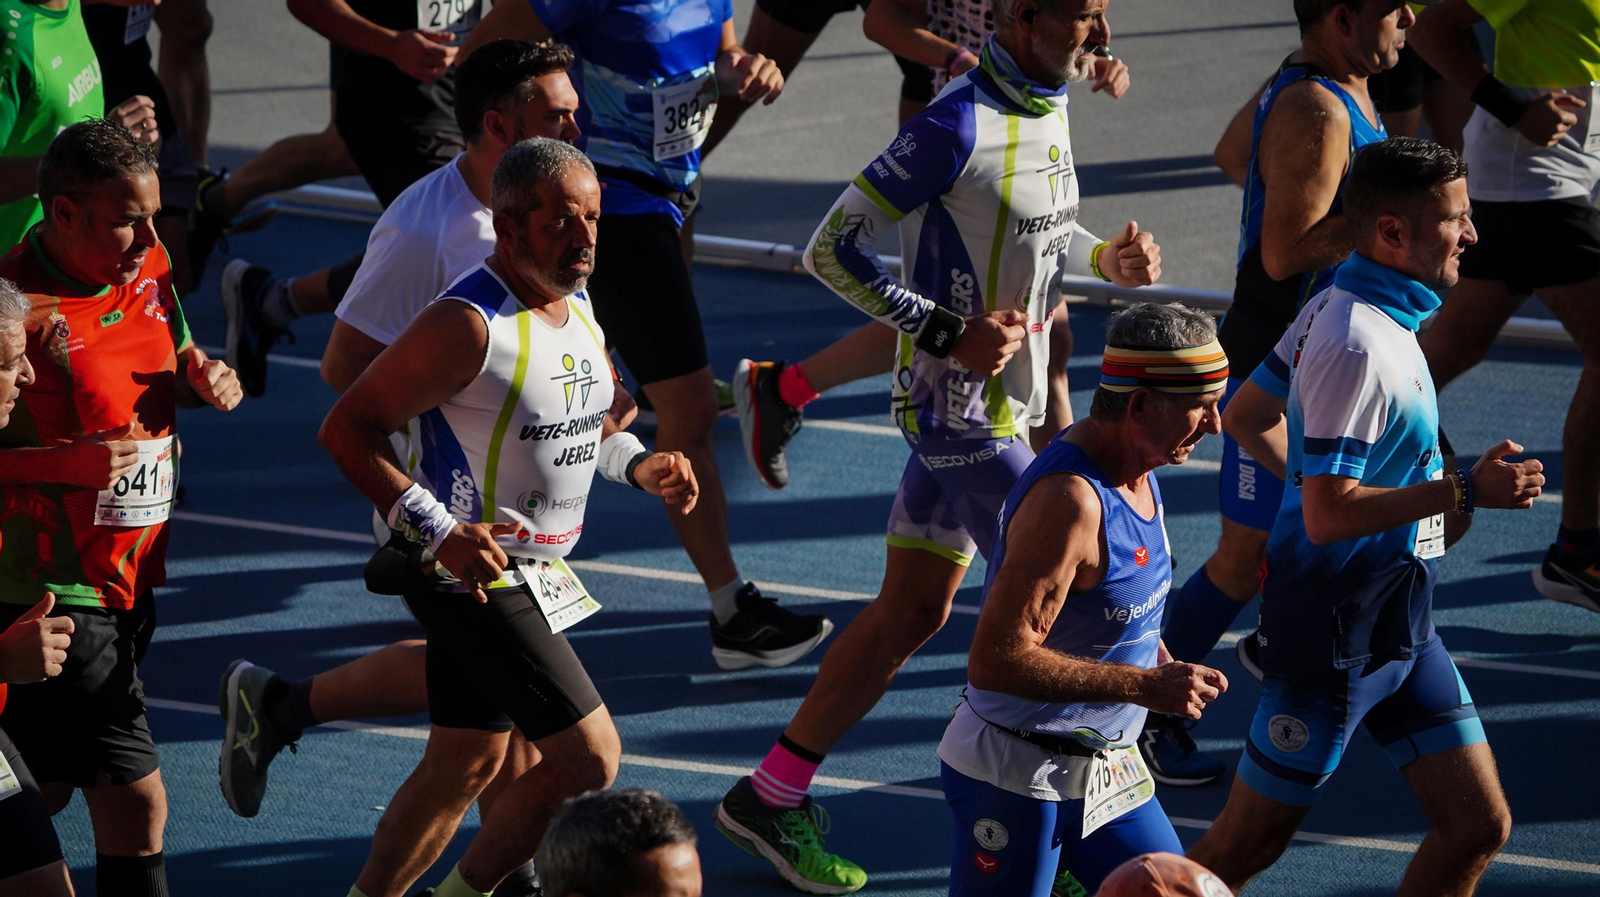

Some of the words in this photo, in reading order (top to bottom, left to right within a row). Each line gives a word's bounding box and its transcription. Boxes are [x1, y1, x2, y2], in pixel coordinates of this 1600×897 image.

[664, 98, 700, 134] 382
[1041, 232, 1070, 258] JEREZ
[553, 441, 596, 467] JEREZ
[928, 442, 1009, 469] SECOVISA
[1238, 462, 1256, 501] DOSA
